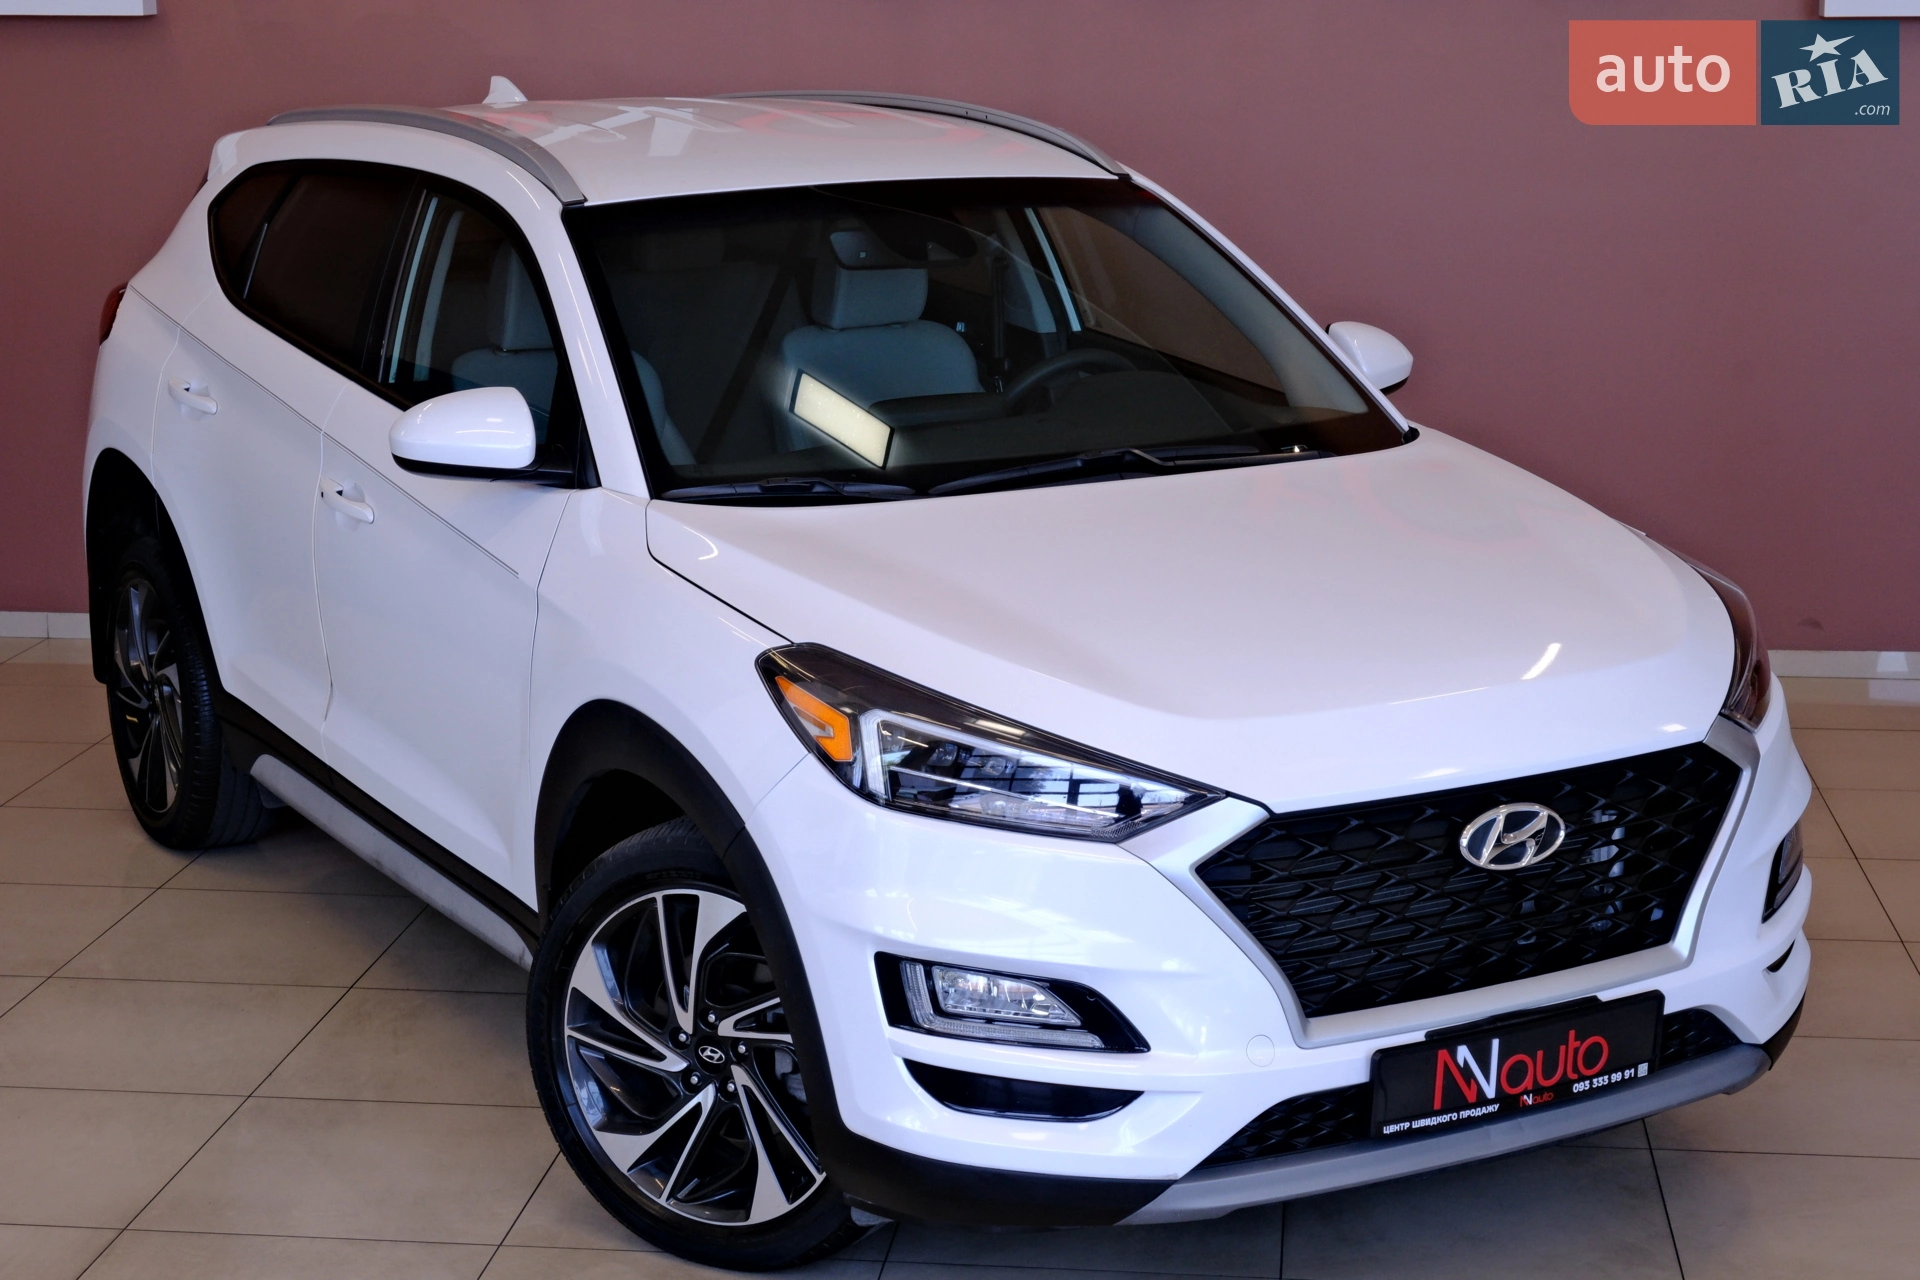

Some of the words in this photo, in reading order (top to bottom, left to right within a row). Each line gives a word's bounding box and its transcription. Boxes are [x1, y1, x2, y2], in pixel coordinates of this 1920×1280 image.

[1573, 1080, 1590, 1094] 093
[1592, 1075, 1609, 1089] 333
[1610, 1071, 1623, 1083] 99
[1624, 1068, 1635, 1080] 91
[1383, 1121, 1410, 1135] ЦЕНТР
[1411, 1112, 1458, 1129] ШВИДКОГО
[1459, 1103, 1500, 1120] ПРОДАЖУ
